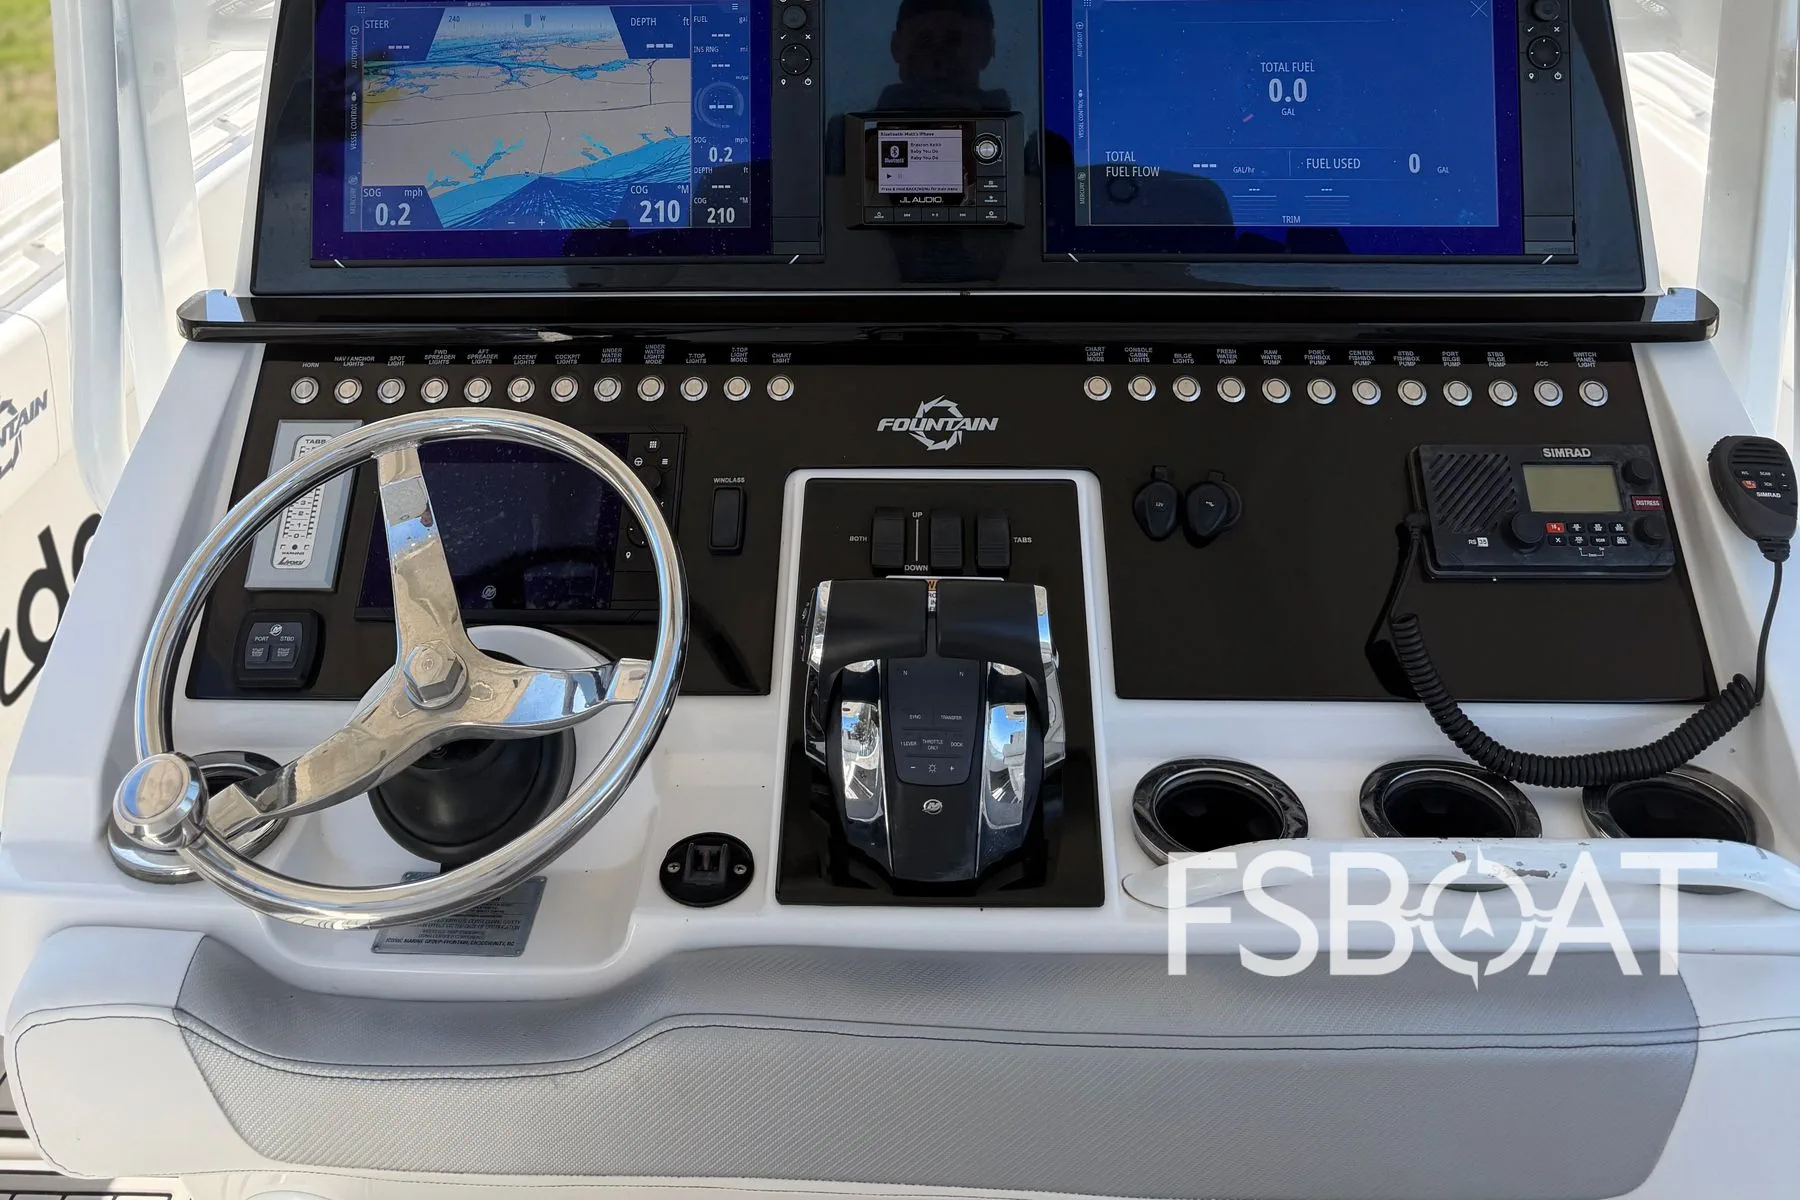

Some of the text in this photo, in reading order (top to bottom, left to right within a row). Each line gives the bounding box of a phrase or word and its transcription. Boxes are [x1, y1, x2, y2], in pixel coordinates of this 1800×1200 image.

[364, 19, 390, 29] STEER
[630, 17, 657, 27] DEPTH
[682, 17, 690, 26] ft
[693, 15, 709, 23] FUEL
[1260, 61, 1316, 73] TOTAL FUEL
[1268, 78, 1308, 103] 0.0
[1281, 107, 1296, 116] GAL
[693, 136, 707, 144] SOG
[734, 137, 749, 145] mph
[709, 147, 733, 163] 0.2
[1105, 151, 1136, 162] TOTAL
[1306, 158, 1361, 169] FUEL USED
[1408, 153, 1421, 174] 0
[693, 166, 713, 174] DEPTH
[1105, 166, 1160, 177] FUEL FLOW
[1436, 166, 1450, 174] GAL
[363, 187, 382, 198] SOG
[404, 187, 423, 200] mph
[630, 185, 649, 195] COG
[900, 196, 943, 204] JL AUDIO
[375, 203, 412, 226] 0.2
[639, 200, 680, 223] 210
[707, 207, 735, 224] 210
[1282, 215, 1300, 224] TRIM
[876, 417, 999, 432] FOUNTAIN
[1543, 448, 1591, 458] SIMRAD
[904, 564, 928, 572] DOWN
